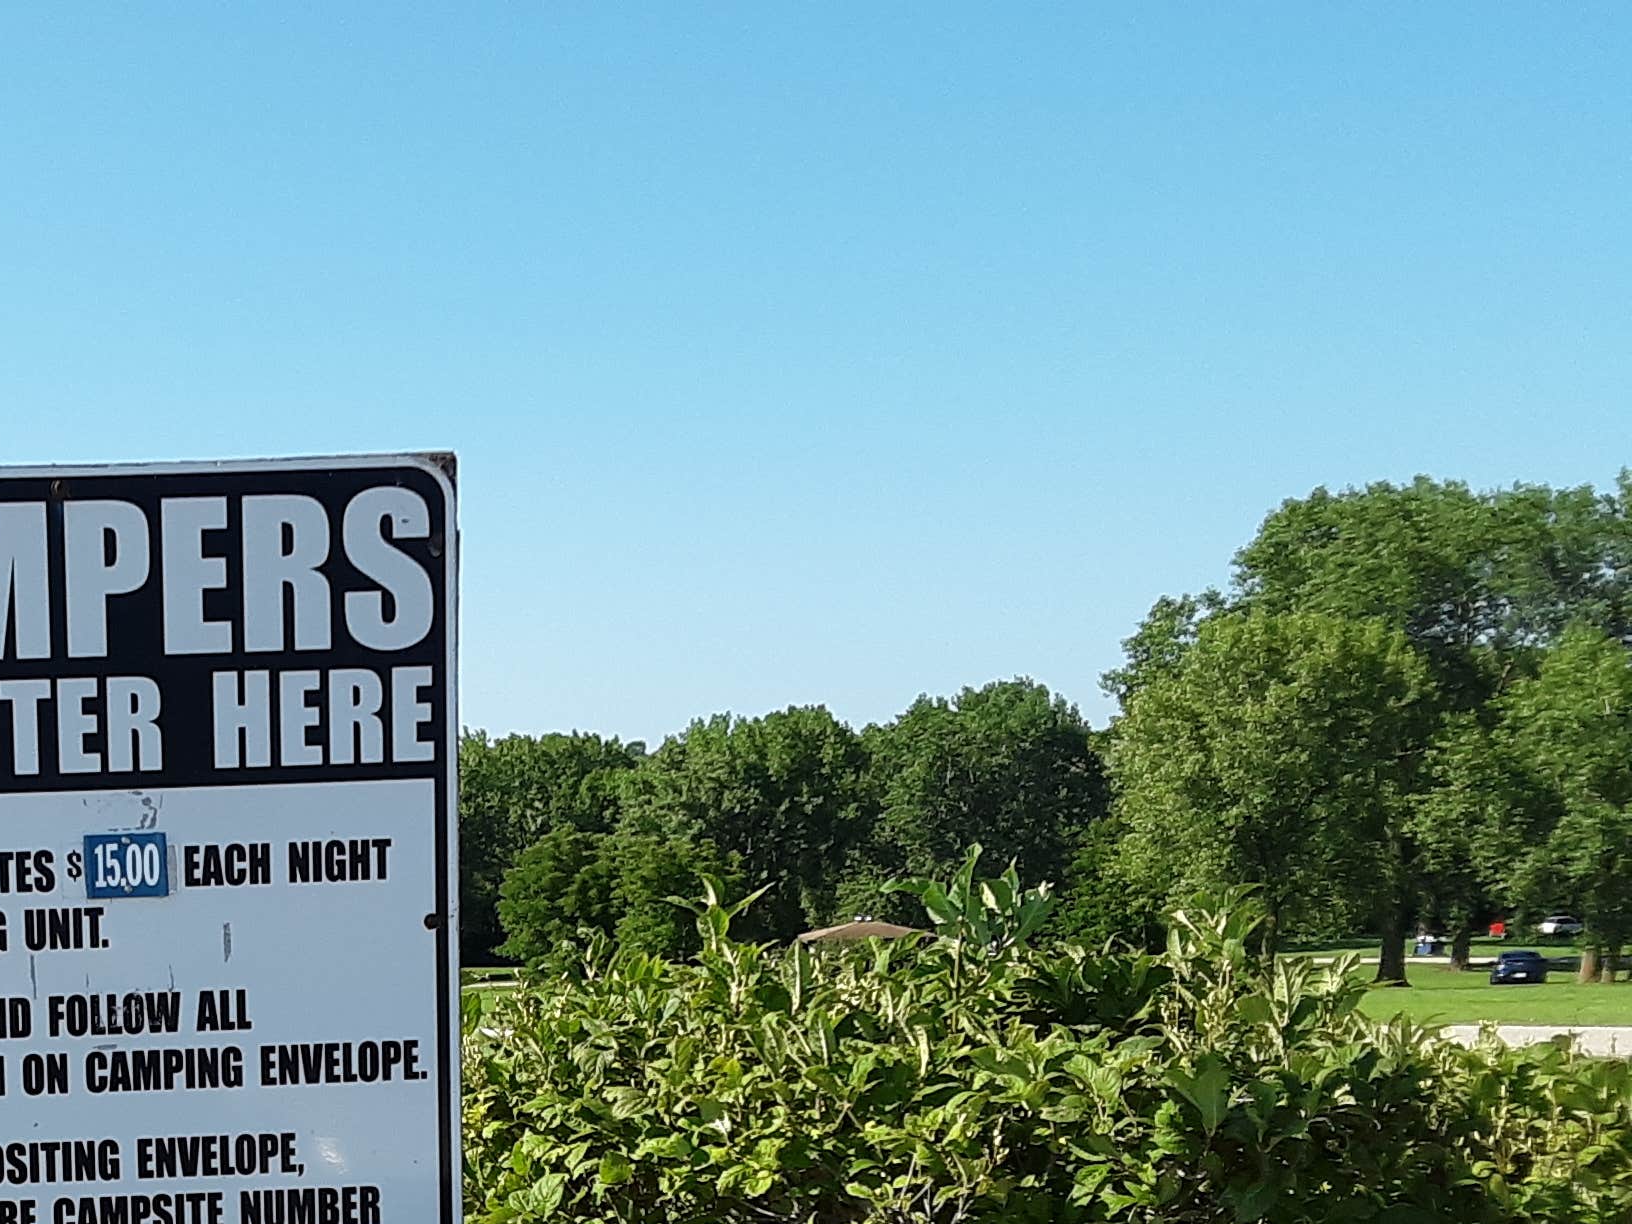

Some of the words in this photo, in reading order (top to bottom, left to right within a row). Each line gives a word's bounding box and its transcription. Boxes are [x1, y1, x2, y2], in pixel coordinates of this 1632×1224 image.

[212, 665, 435, 768] HERE
[184, 843, 271, 887] EACH
[289, 839, 392, 883] NIGHT
[24, 907, 109, 951] UNIT.
[48, 992, 181, 1037] FOLLOW
[197, 989, 252, 1031] ALL
[23, 1053, 68, 1095] ON
[86, 1047, 243, 1093] CAMPING
[261, 1040, 428, 1087] ENVELOPE.
[137, 1133, 304, 1179] ENVELOPE,
